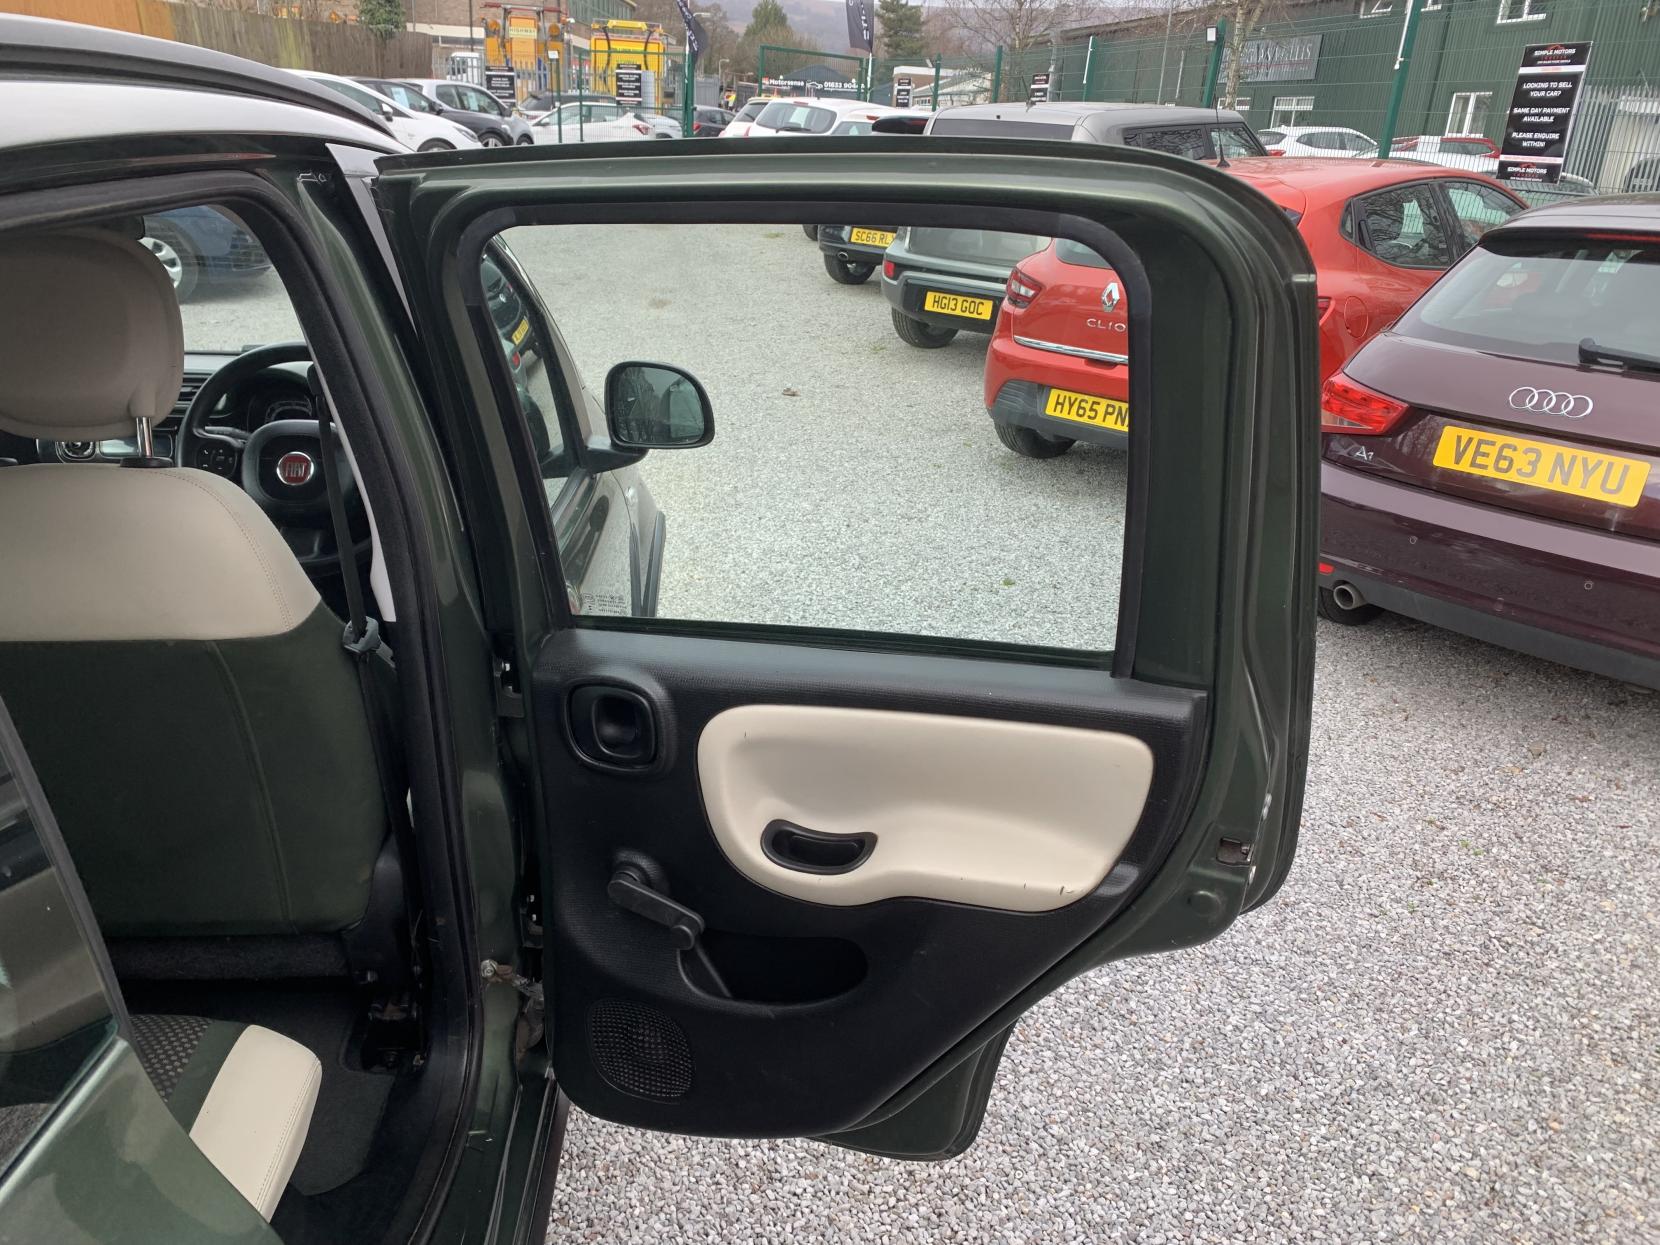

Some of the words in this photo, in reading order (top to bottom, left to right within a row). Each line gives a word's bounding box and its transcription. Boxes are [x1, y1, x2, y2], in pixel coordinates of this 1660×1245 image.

[855, 231, 877, 243] SC66
[932, 294, 957, 311] HG13
[960, 299, 984, 315] GOC
[1086, 318, 1126, 332] CLIO
[1053, 393, 1100, 420] HY65
[285, 462, 307, 477] FIAT
[1453, 434, 1542, 478] VE63
[1547, 452, 1631, 495] NYU
